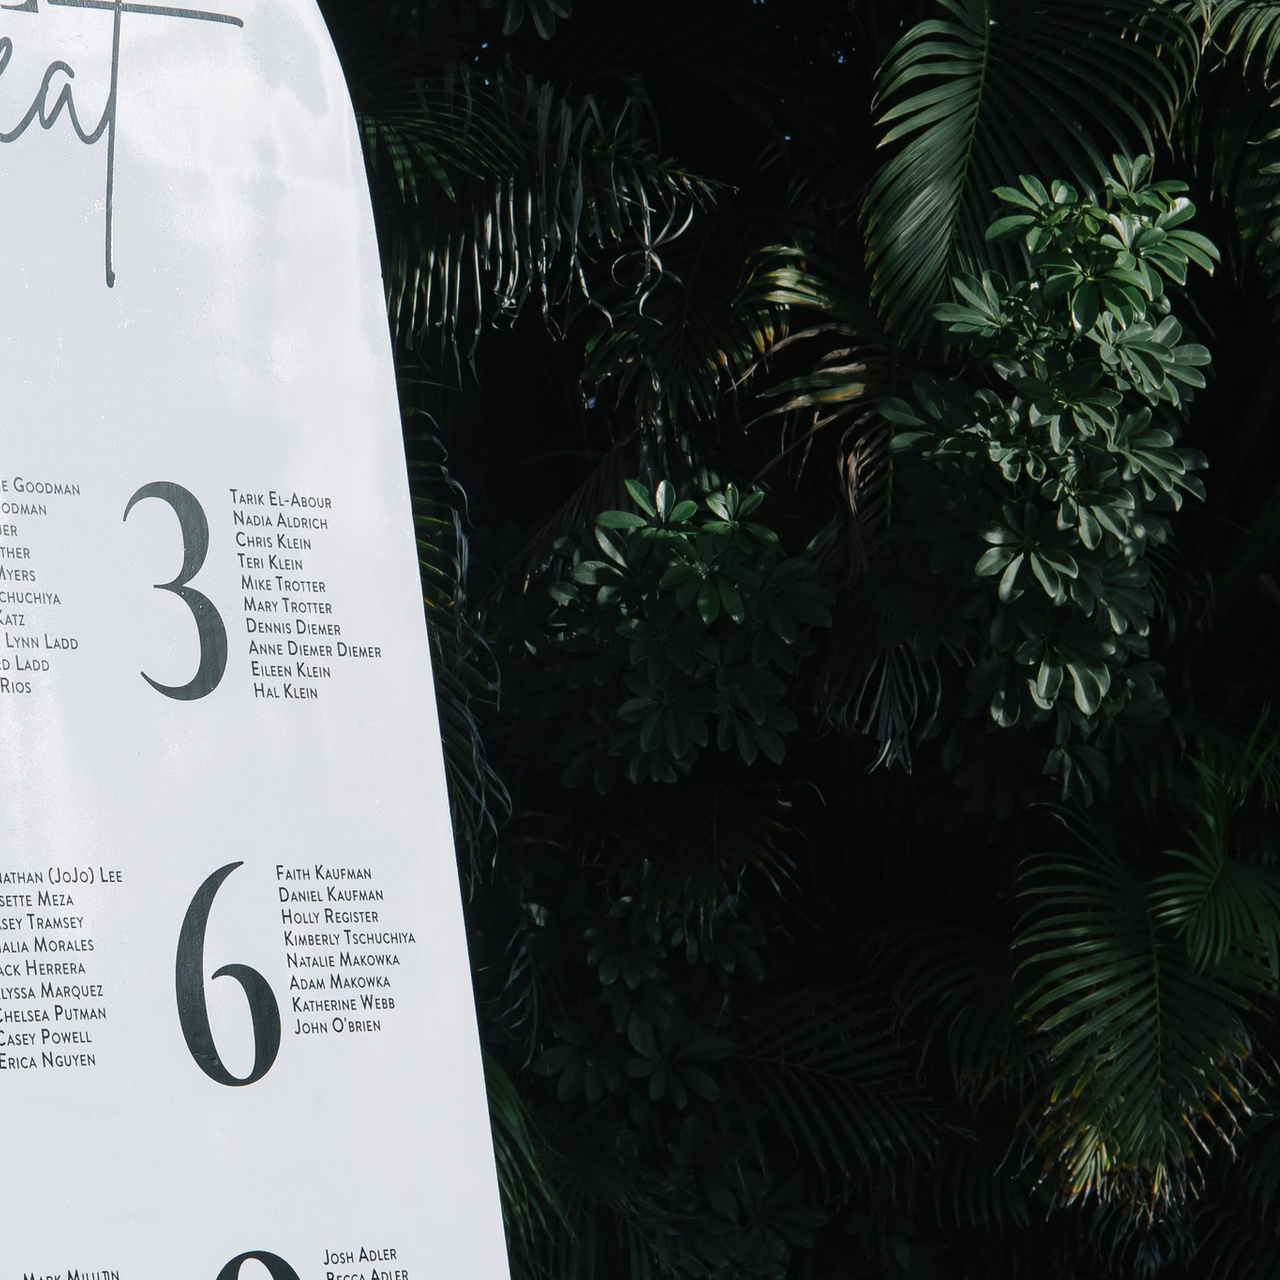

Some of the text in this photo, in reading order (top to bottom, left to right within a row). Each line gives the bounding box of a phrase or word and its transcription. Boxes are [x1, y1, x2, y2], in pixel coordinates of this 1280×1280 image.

[13, 476, 80, 496] GOODMAN
[229, 488, 332, 509] TARIK EL-ABOUR
[233, 510, 328, 529] NADIA ALDRICH
[236, 531, 311, 550] CHRIS KLEIN
[123, 481, 228, 701] 3
[242, 574, 326, 593] MIKE TROTTER
[246, 617, 341, 636] DENNIS DIEMER
[5, 632, 39, 649] LYNN
[44, 633, 78, 650] LADD
[15, 655, 50, 672] LADD
[251, 660, 331, 678] EILEEN KLEIN
[253, 682, 318, 699] HAL KLEIN
[48, 867, 94, 885] (JOJO)
[100, 866, 123, 883] LEE
[276, 864, 372, 881] FAITH KAUFMAN
[38, 890, 74, 907] MEZA
[26, 913, 83, 930] TRAMSEY
[281, 908, 379, 924] HOLLY REGISTER
[34, 936, 94, 953] MORALES
[284, 929, 416, 946] KIMBERLY TSCHUCHIYA
[287, 951, 400, 968] NATALIE MAKOWKA
[175, 861, 281, 1087] 6
[41, 982, 103, 1000] MARQUEZ
[292, 994, 395, 1012] KATHERINE WEBB
[54, 1004, 106, 1021] PUTMAN
[295, 1017, 381, 1035] JOHN O'BRIEN
[41, 1051, 96, 1068] NGUYEN
